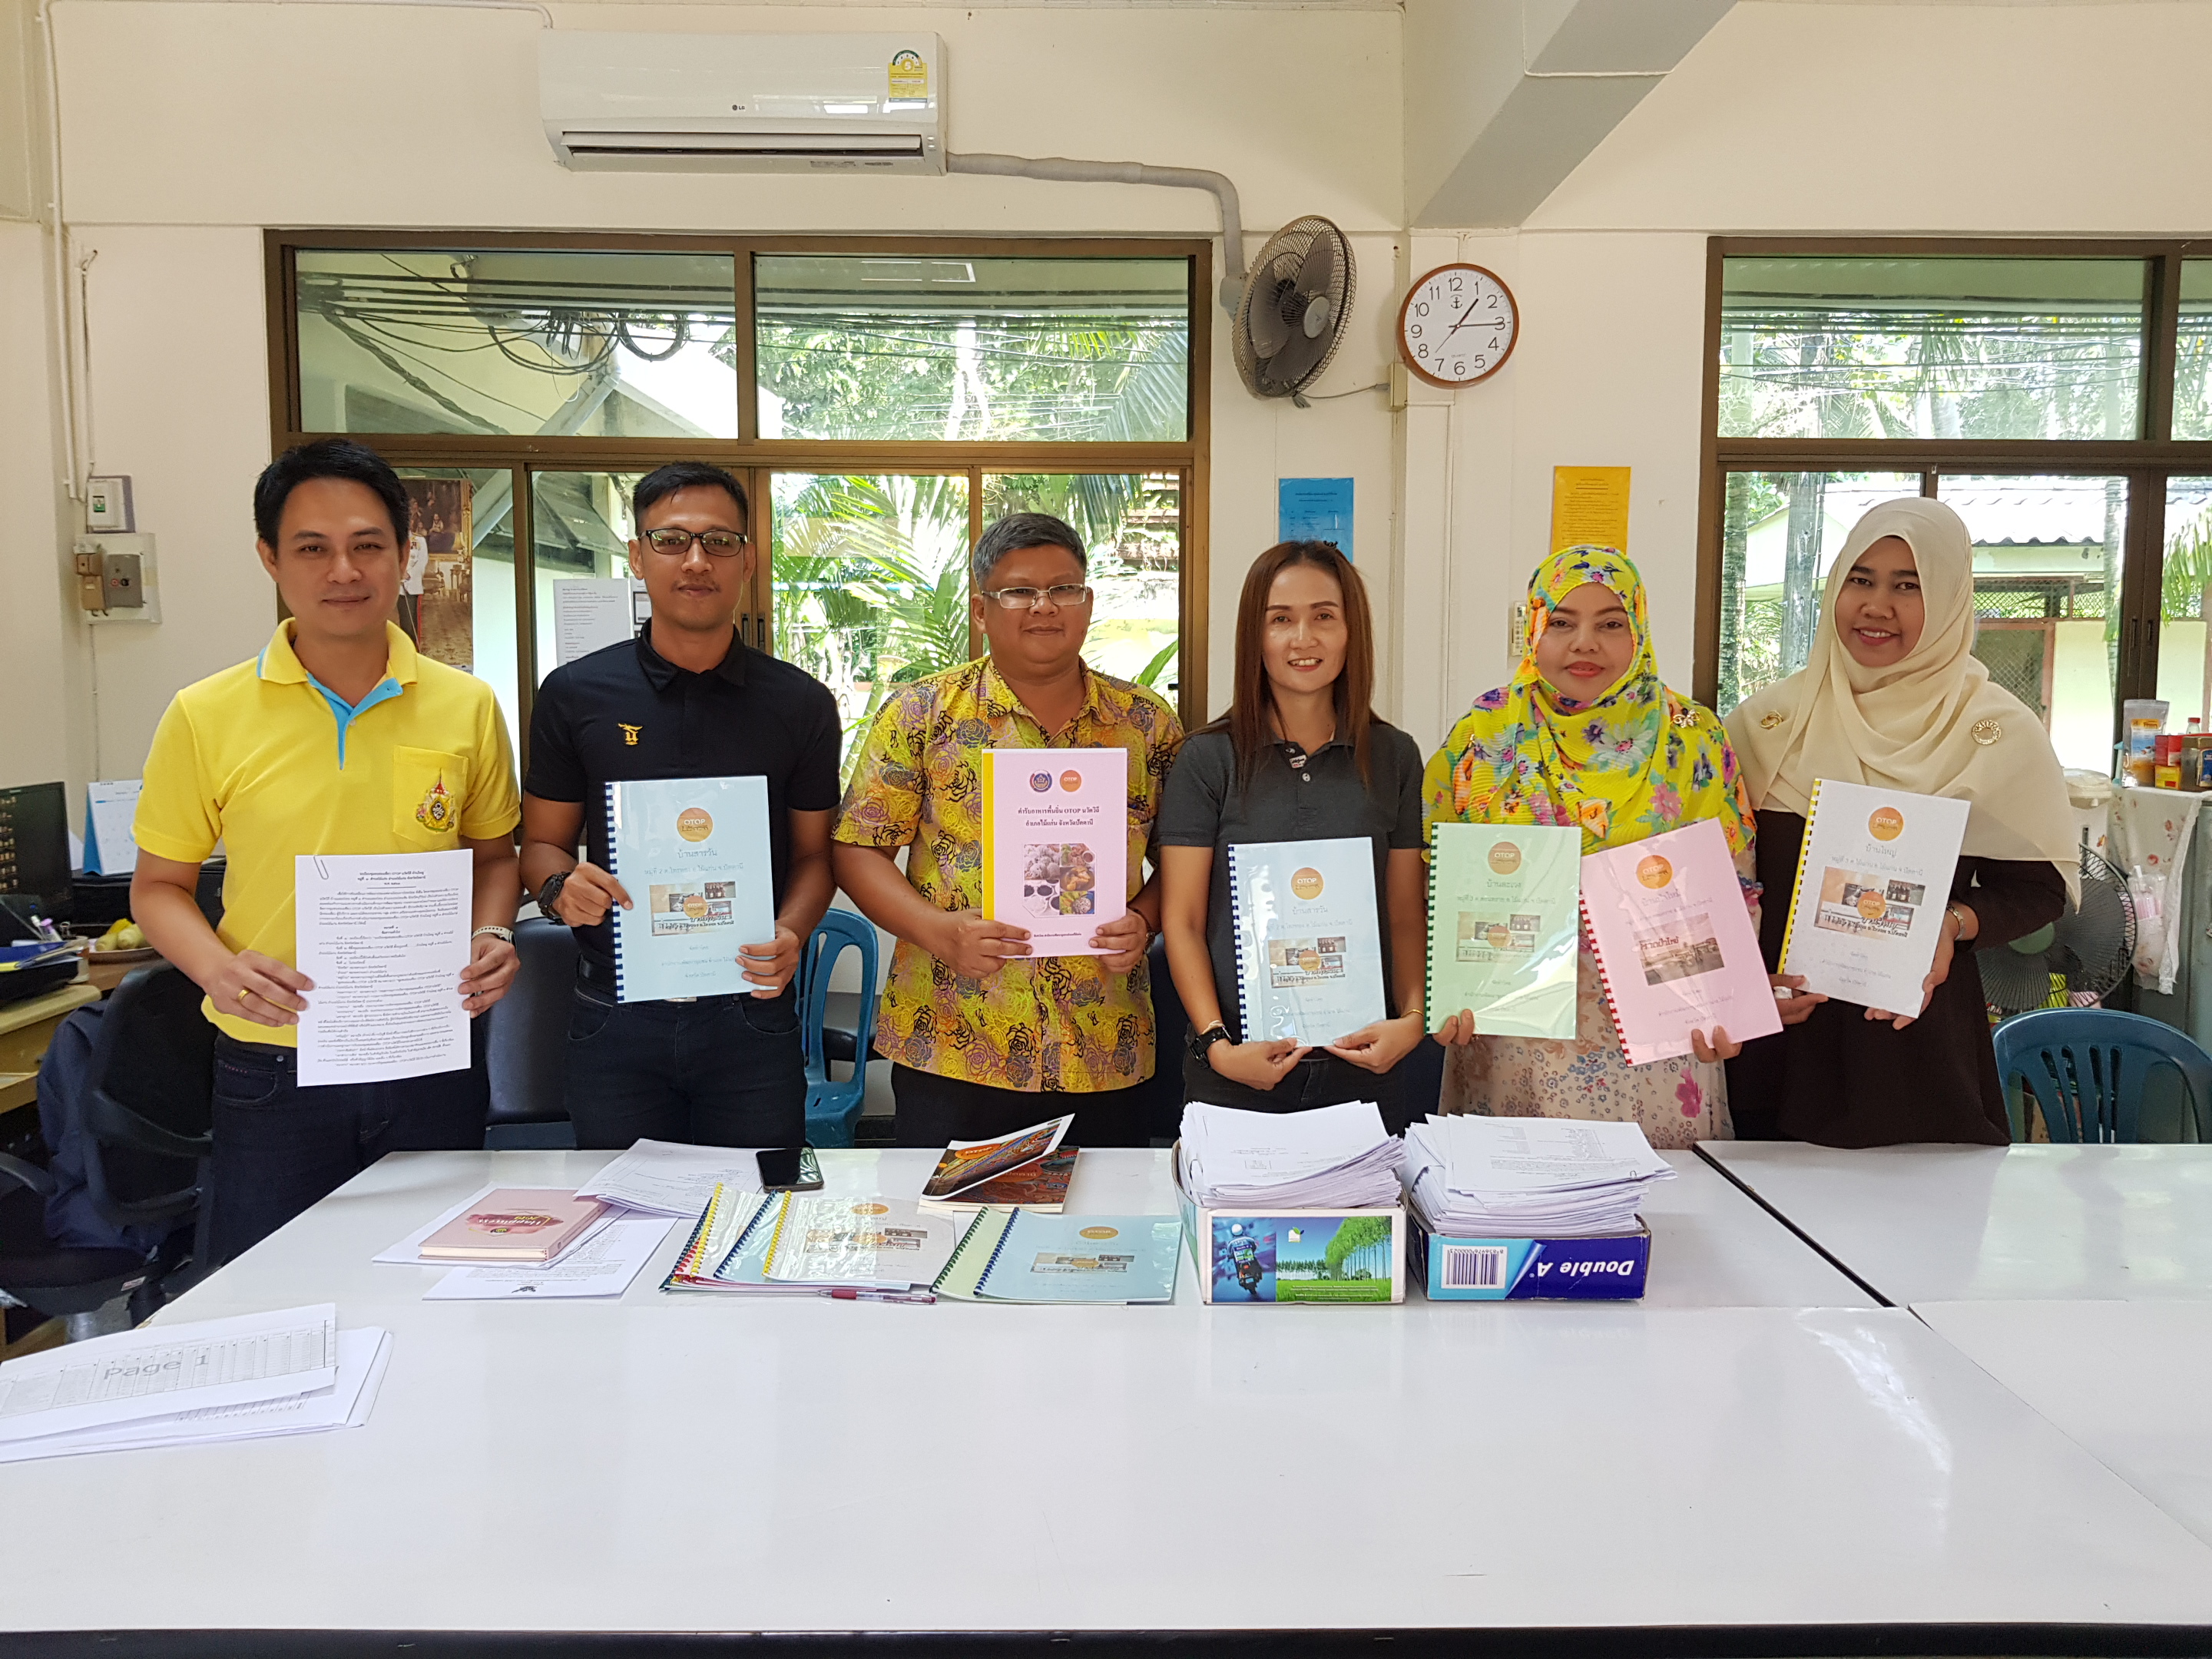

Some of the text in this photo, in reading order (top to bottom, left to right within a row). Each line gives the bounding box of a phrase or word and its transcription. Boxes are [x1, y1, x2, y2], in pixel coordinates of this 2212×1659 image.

[1448, 277, 1462, 292] 12
[1475, 281, 1479, 295] 1
[1429, 286, 1440, 300] 11
[1487, 295, 1498, 309] 2
[1415, 303, 1429, 317] 10
[1495, 316, 1505, 330] 3
[1411, 325, 1422, 338] 9
[1488, 336, 1499, 351] 4
[1418, 344, 1429, 359] 8
[1435, 359, 1445, 372] 7
[1454, 362, 1465, 375] 6
[1475, 355, 1485, 369] 5
[1560, 1260, 1634, 1277] Double
[104, 1356, 209, 1380] Page 1
